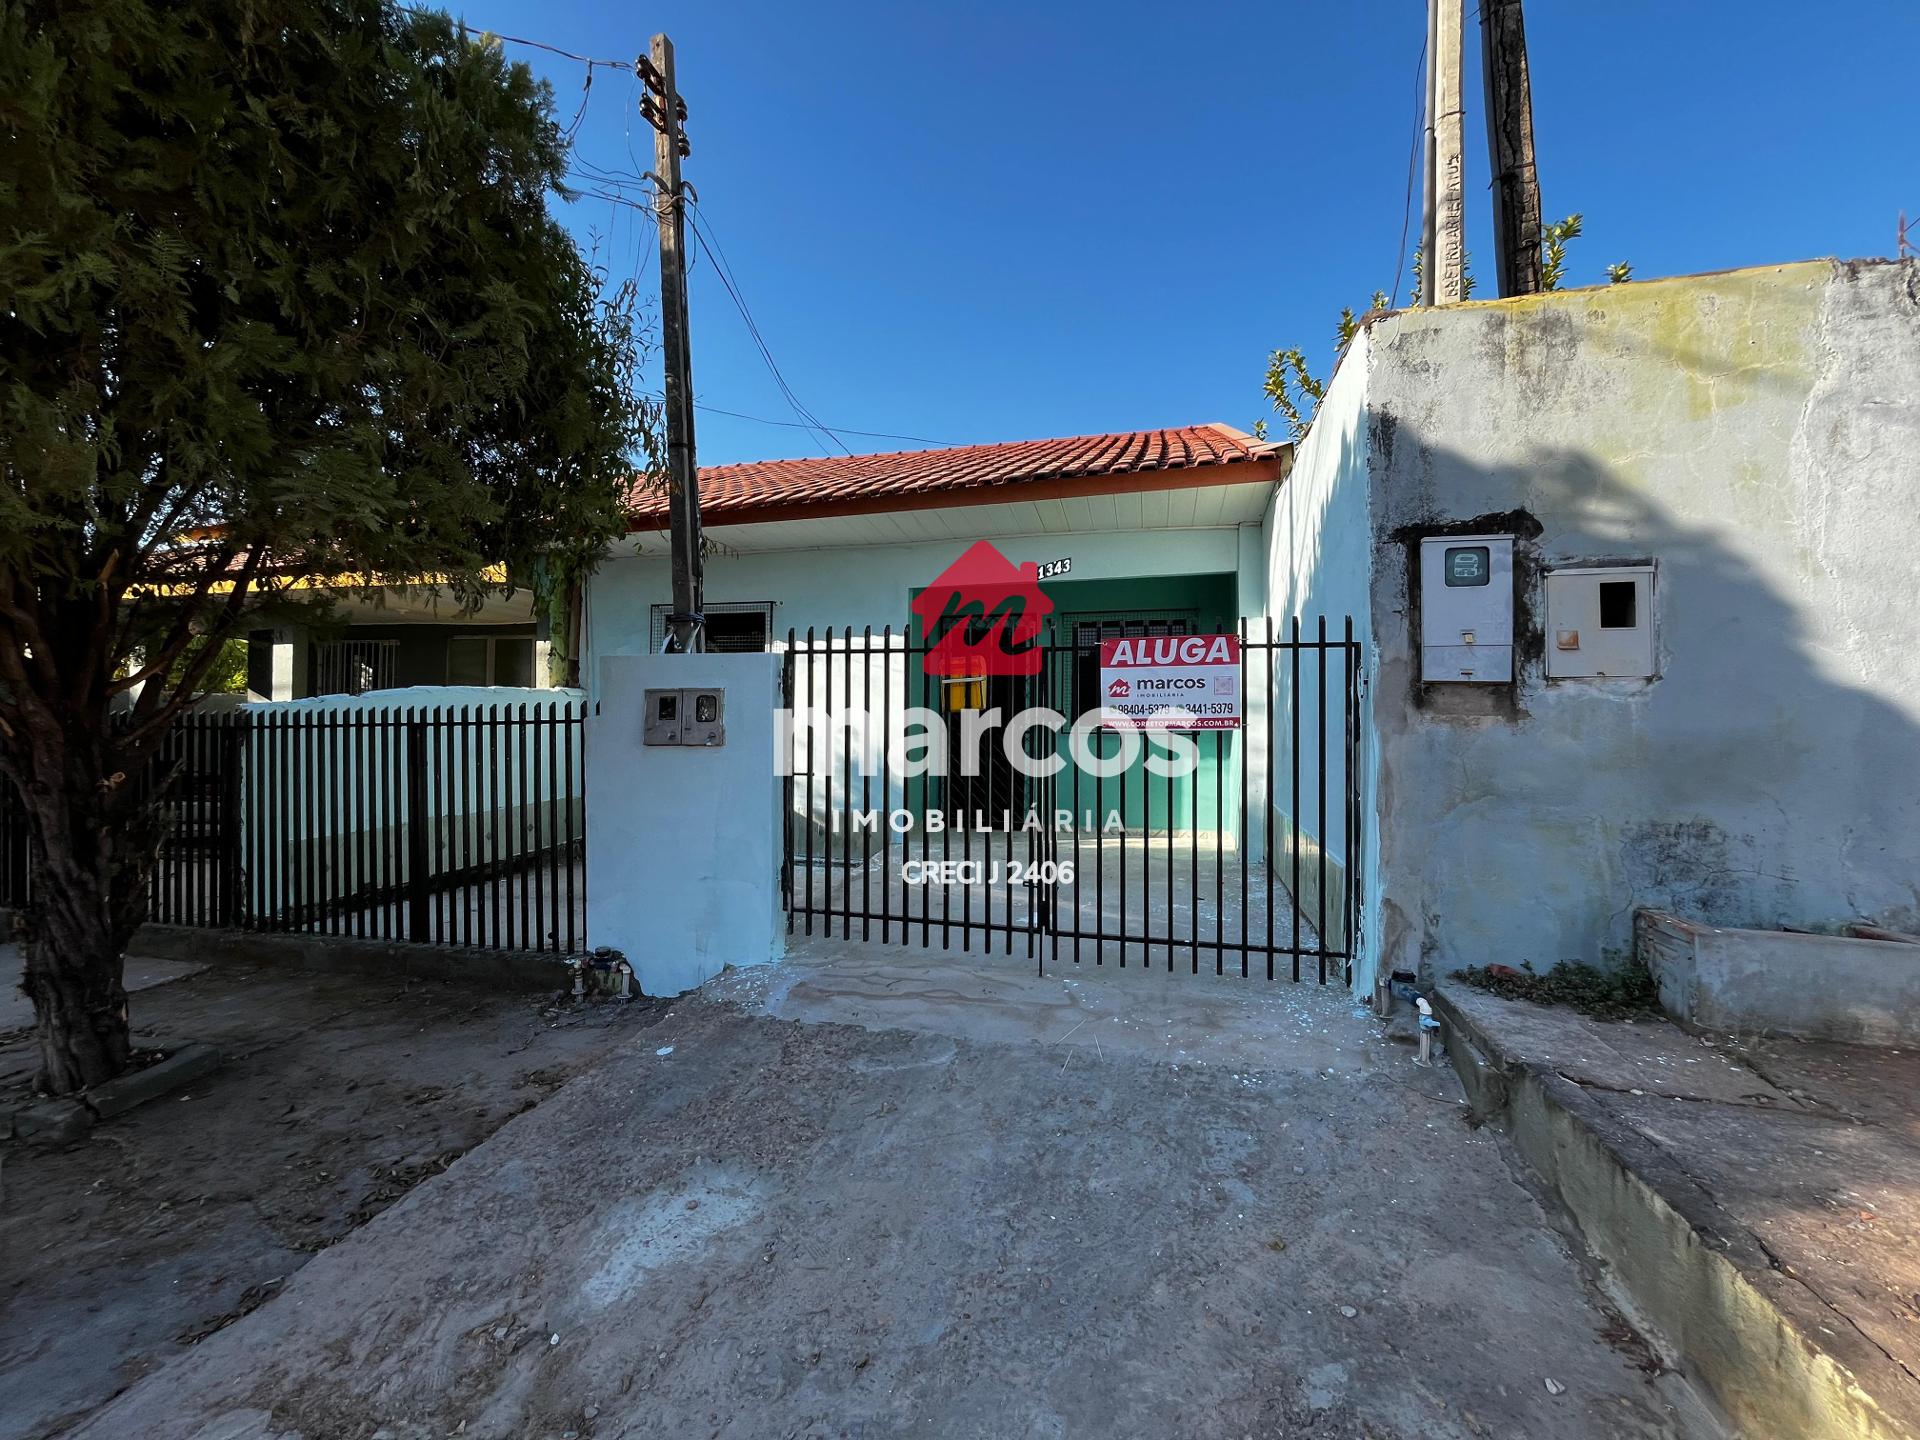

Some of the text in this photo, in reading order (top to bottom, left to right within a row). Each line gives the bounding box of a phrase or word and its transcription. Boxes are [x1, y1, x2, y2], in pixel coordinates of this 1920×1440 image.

[1037, 559, 1071, 579] 1343
[1110, 636, 1231, 666] ALUGA
[1136, 677, 1206, 690] marcos
[1118, 703, 1170, 715] 98404-5379
[1185, 702, 1233, 714] 3441-5379
